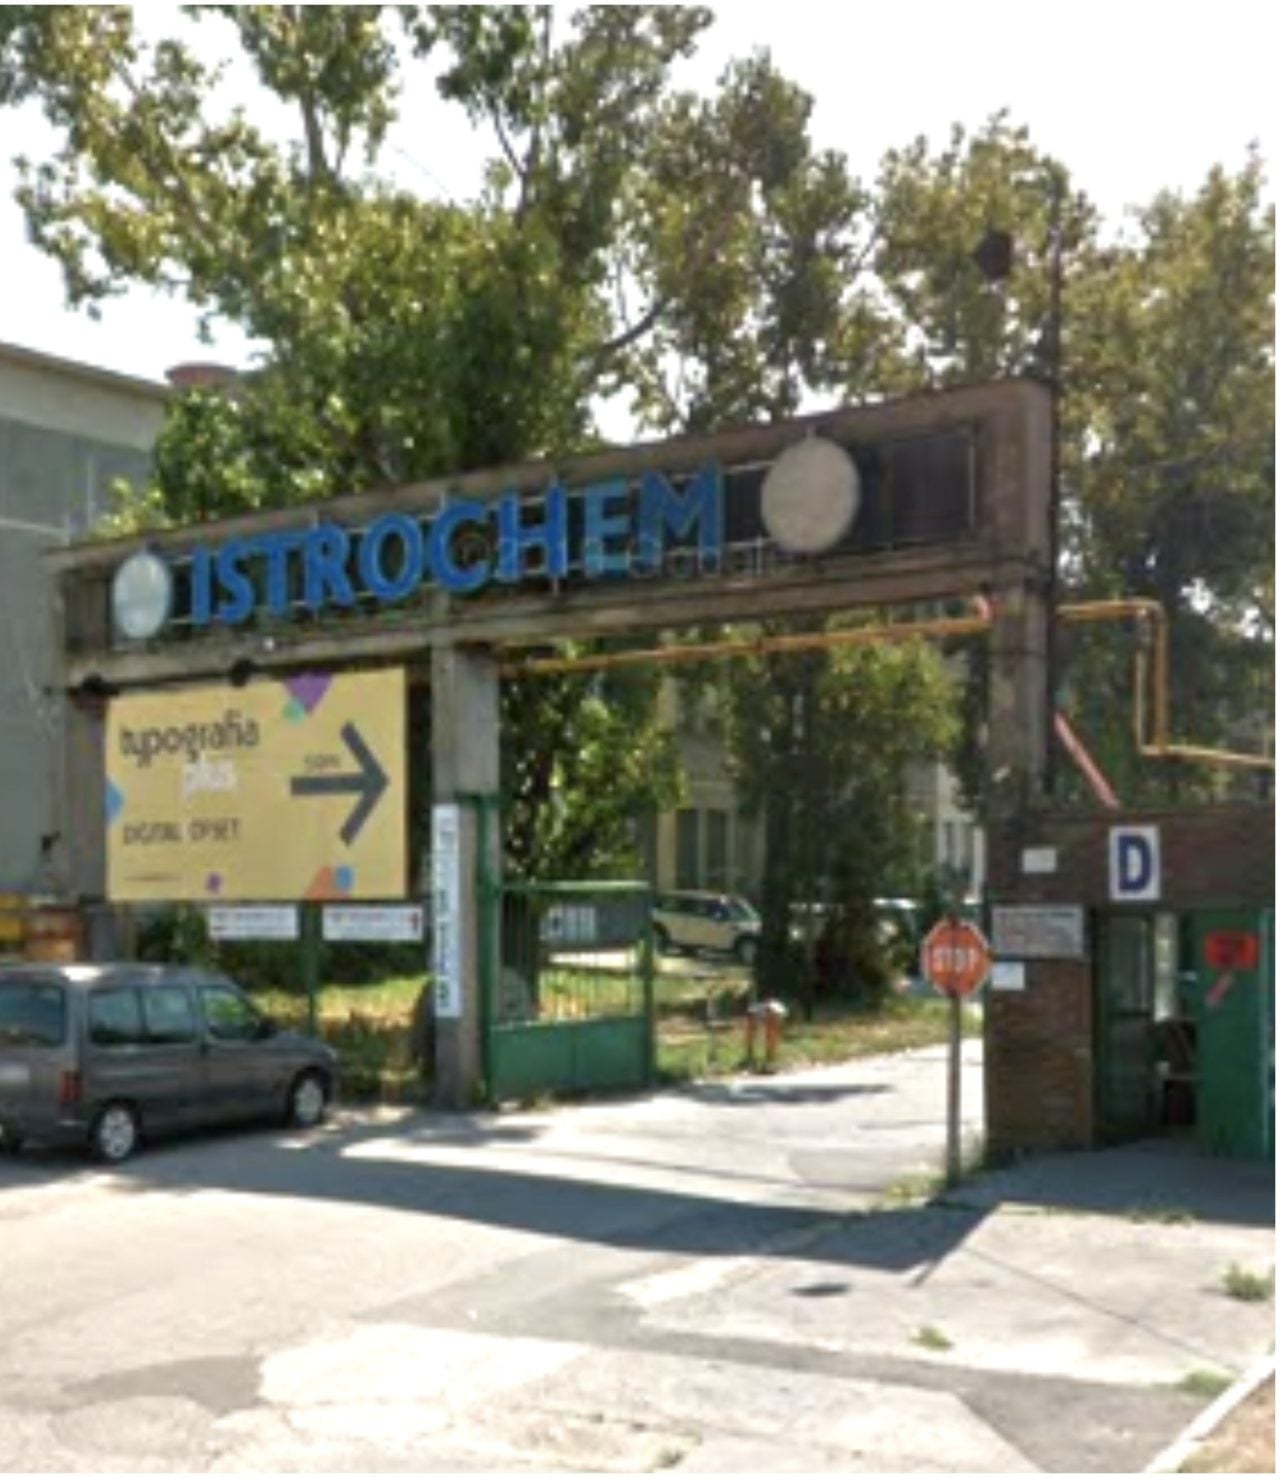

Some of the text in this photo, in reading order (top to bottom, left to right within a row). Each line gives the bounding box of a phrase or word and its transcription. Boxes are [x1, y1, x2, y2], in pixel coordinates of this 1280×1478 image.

[191, 468, 723, 625] ISTROCHEM
[120, 708, 260, 769] typografia
[1118, 835, 1152, 892] D
